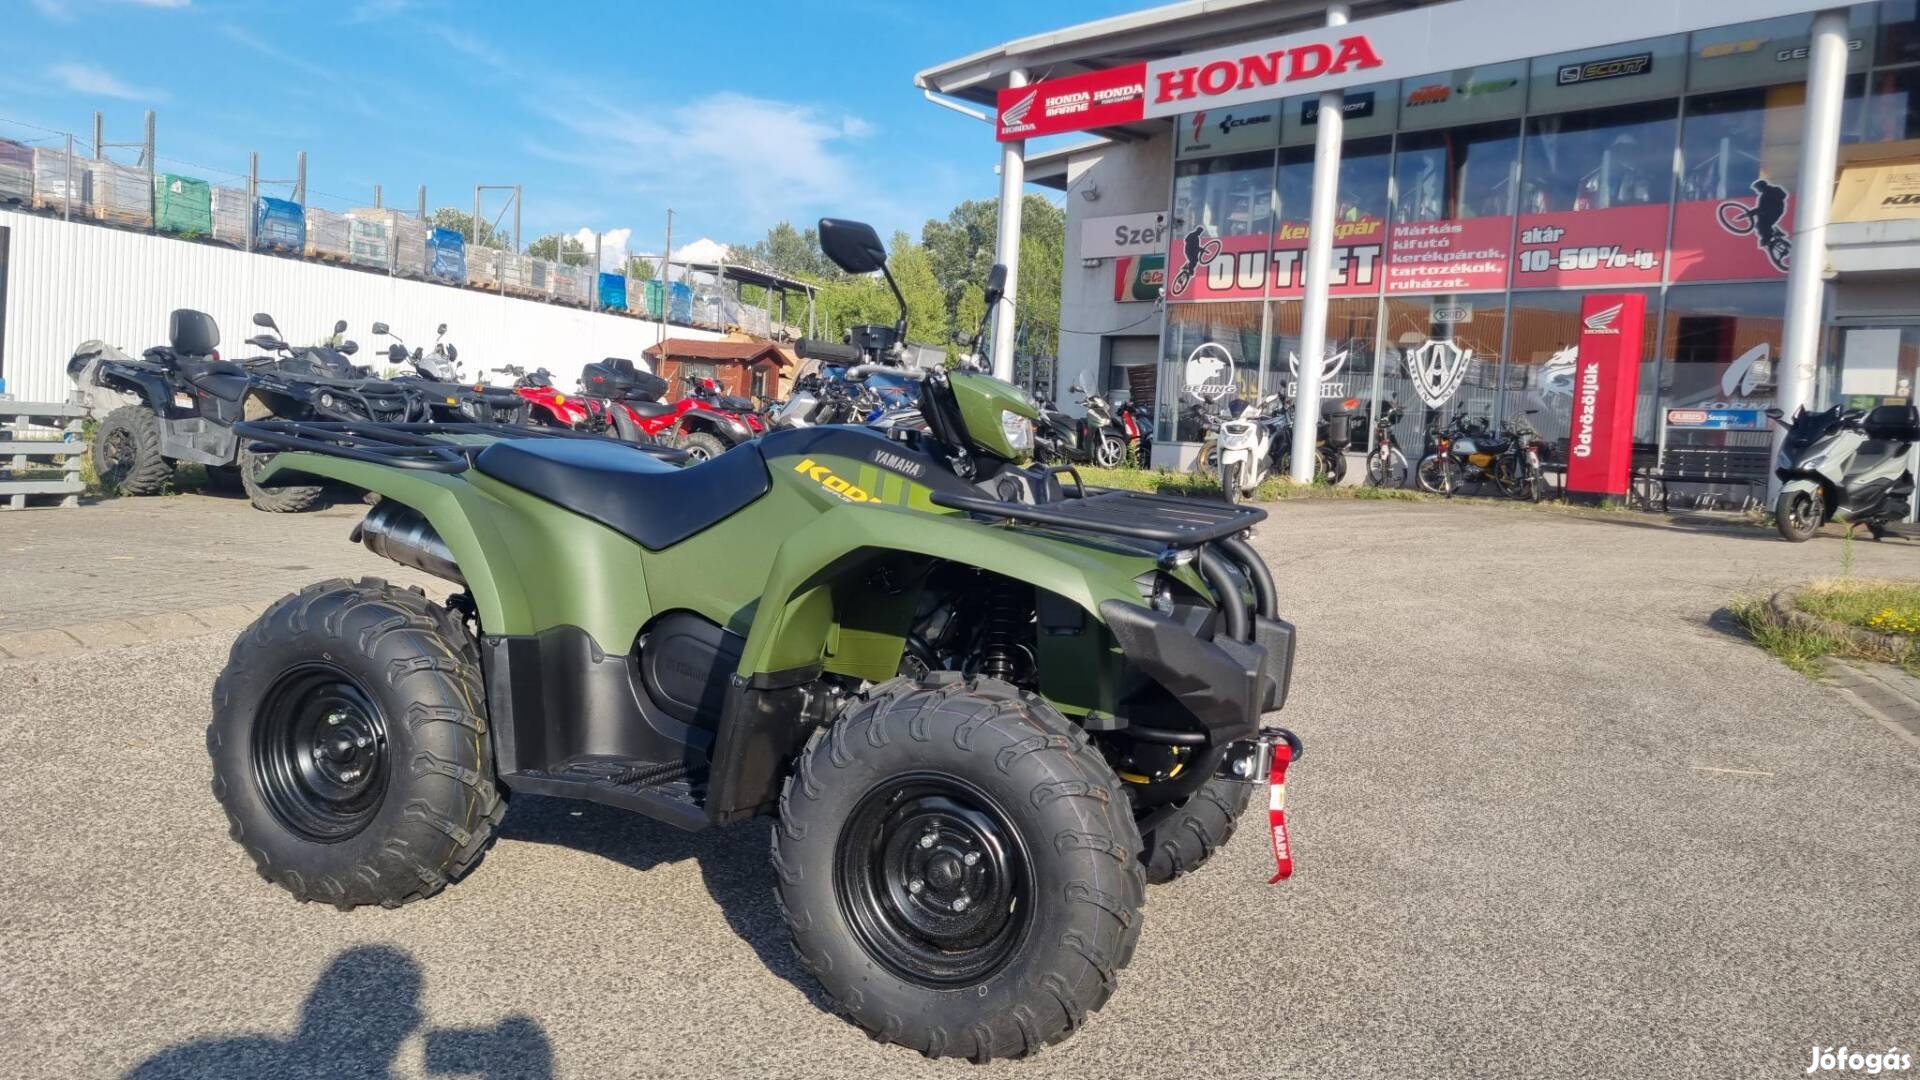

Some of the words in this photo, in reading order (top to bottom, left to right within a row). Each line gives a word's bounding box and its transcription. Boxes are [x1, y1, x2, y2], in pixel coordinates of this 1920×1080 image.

[1154, 35, 1383, 103] HONDA
[1584, 57, 1647, 77] SCOTT
[1045, 91, 1090, 107] HONDA
[1093, 83, 1144, 101] HONDA
[1045, 102, 1089, 117] MARINE
[1002, 123, 1036, 135] HONDA
[1230, 114, 1272, 127] CUBE
[1279, 218, 1382, 241] kekpár
[1394, 223, 1464, 237] Márkás
[1522, 226, 1565, 244] akár
[1392, 248, 1506, 263] kerékpárok,
[1519, 245, 1659, 272] 10-50%-ig.
[1391, 262, 1503, 276] tartozékok,
[1390, 278, 1470, 290] ruházat.
[1182, 384, 1237, 394] BERING
[1573, 362, 1599, 458] Üdvözöljük
[873, 450, 922, 477] YAMAHA
[794, 458, 881, 504] KOD
[1273, 825, 1289, 860] WARN
